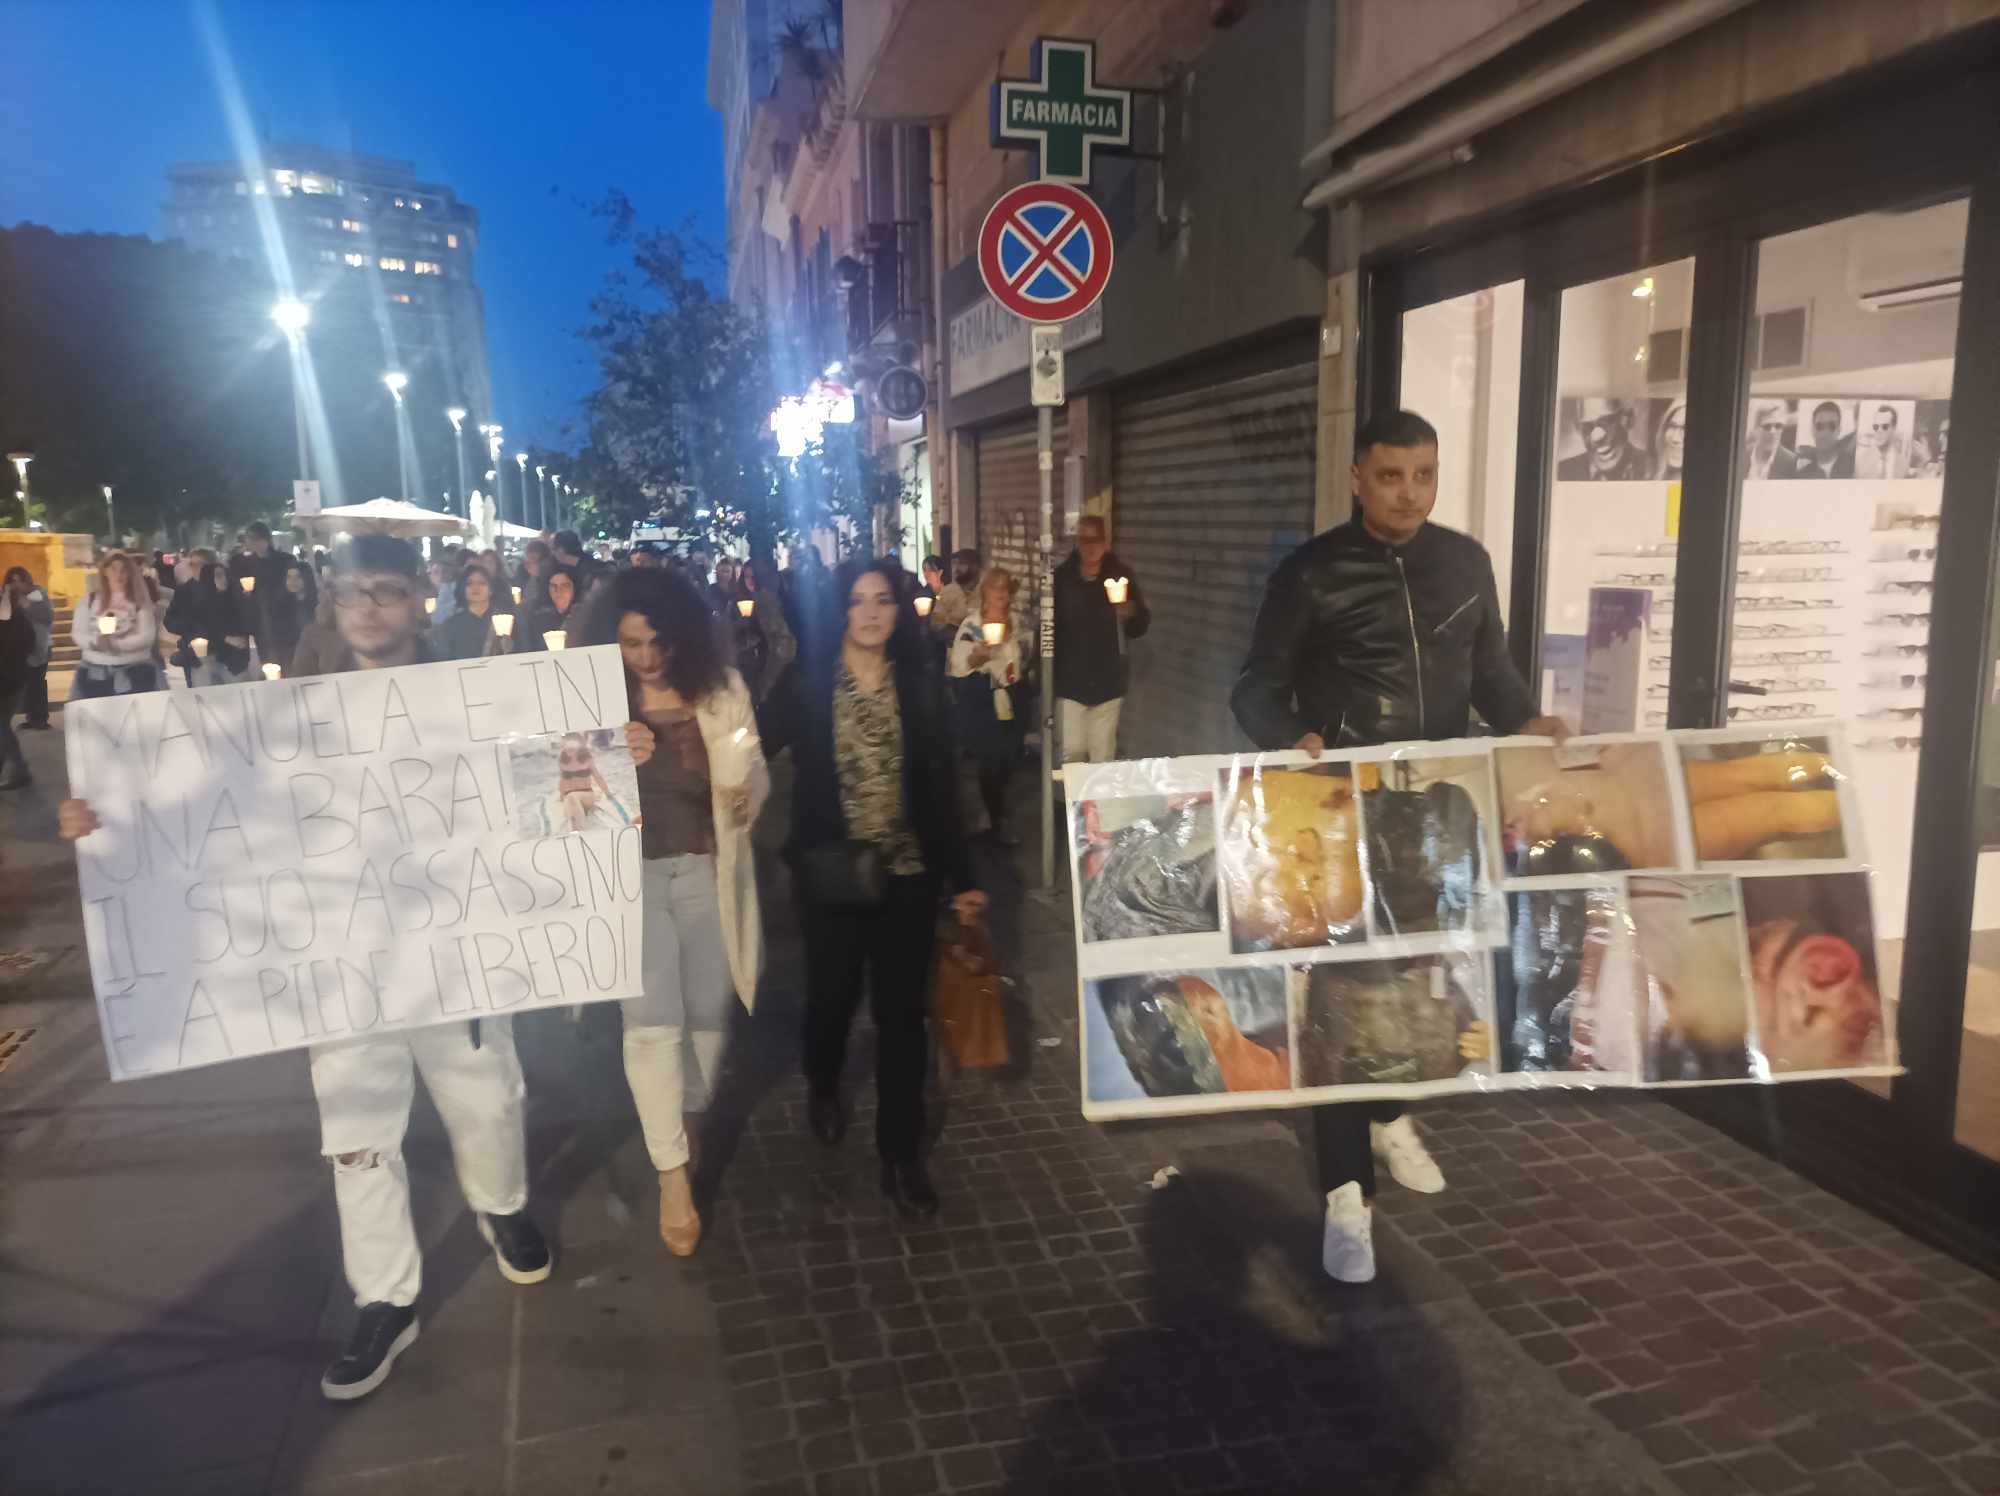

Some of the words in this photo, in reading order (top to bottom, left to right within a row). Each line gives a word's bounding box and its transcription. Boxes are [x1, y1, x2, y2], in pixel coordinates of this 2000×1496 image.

[1011, 98, 1118, 128] FARMACIA
[76, 677, 422, 780] MANUELA
[519, 653, 603, 736] IN
[88, 786, 253, 883] UNA
[287, 742, 512, 858] BARA!
[89, 895, 168, 984] IL
[184, 867, 317, 965] SUO
[345, 825, 642, 940] ASSASSINO
[177, 978, 234, 1065] A
[257, 949, 405, 1047] PIEDE
